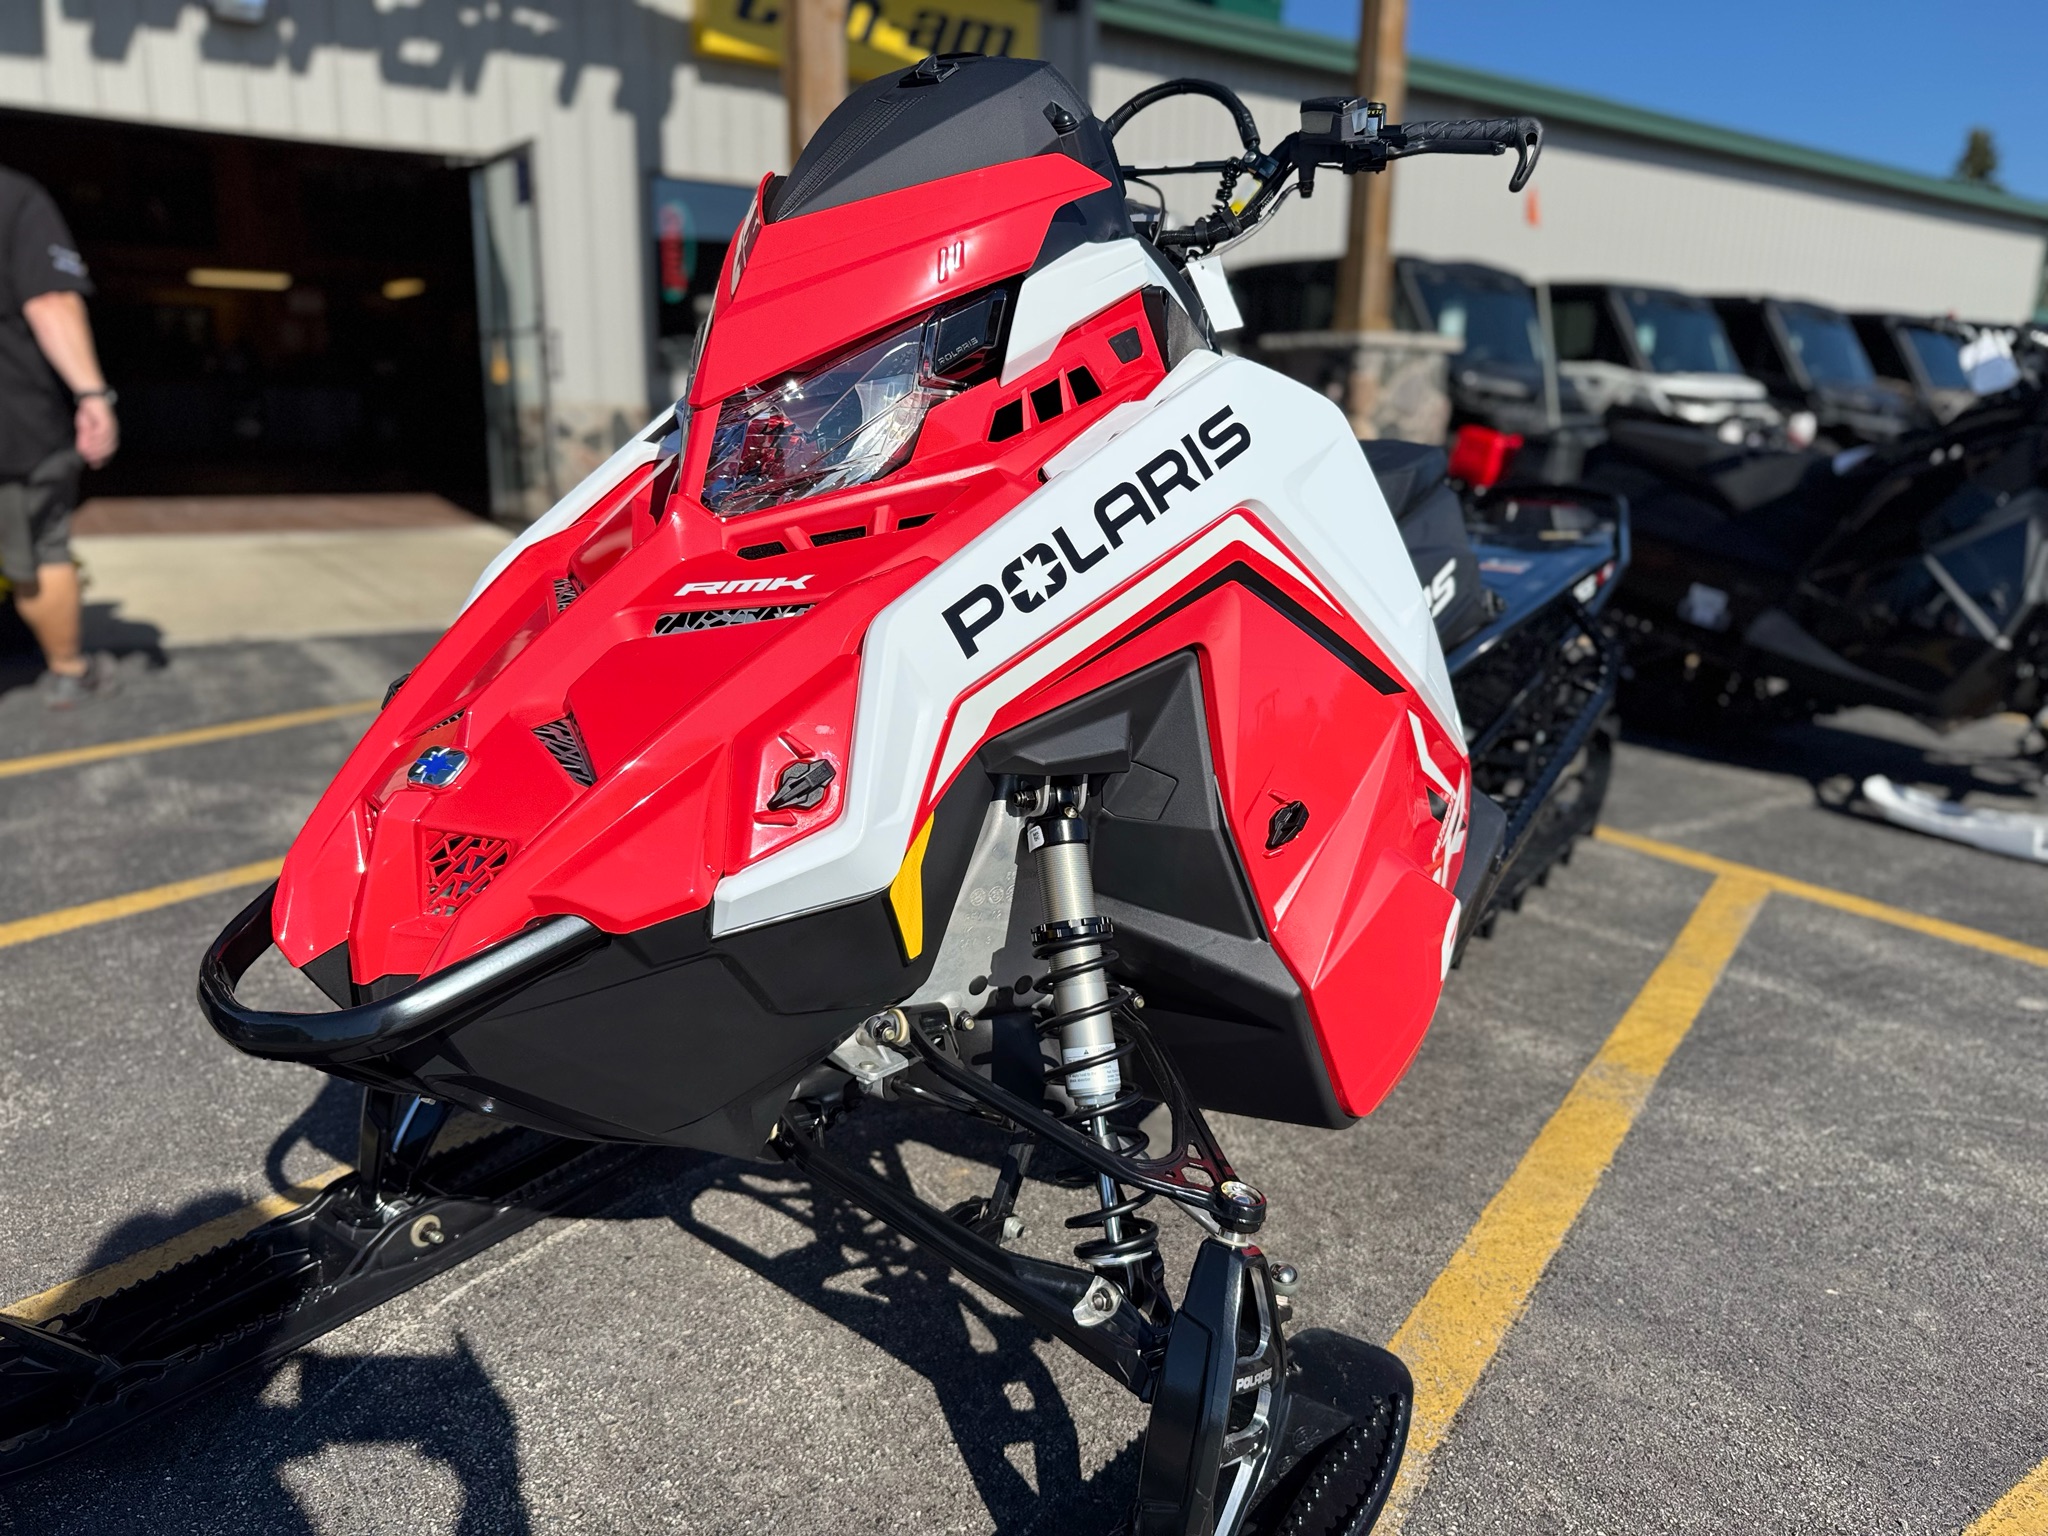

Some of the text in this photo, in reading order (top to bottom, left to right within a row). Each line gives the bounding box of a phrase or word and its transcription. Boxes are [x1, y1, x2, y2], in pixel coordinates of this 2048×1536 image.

[938, 337, 979, 365] POLARIS
[941, 404, 1251, 660] POLARIS
[674, 574, 816, 597] RMK
[1236, 1367, 1272, 1392] POLARIS
